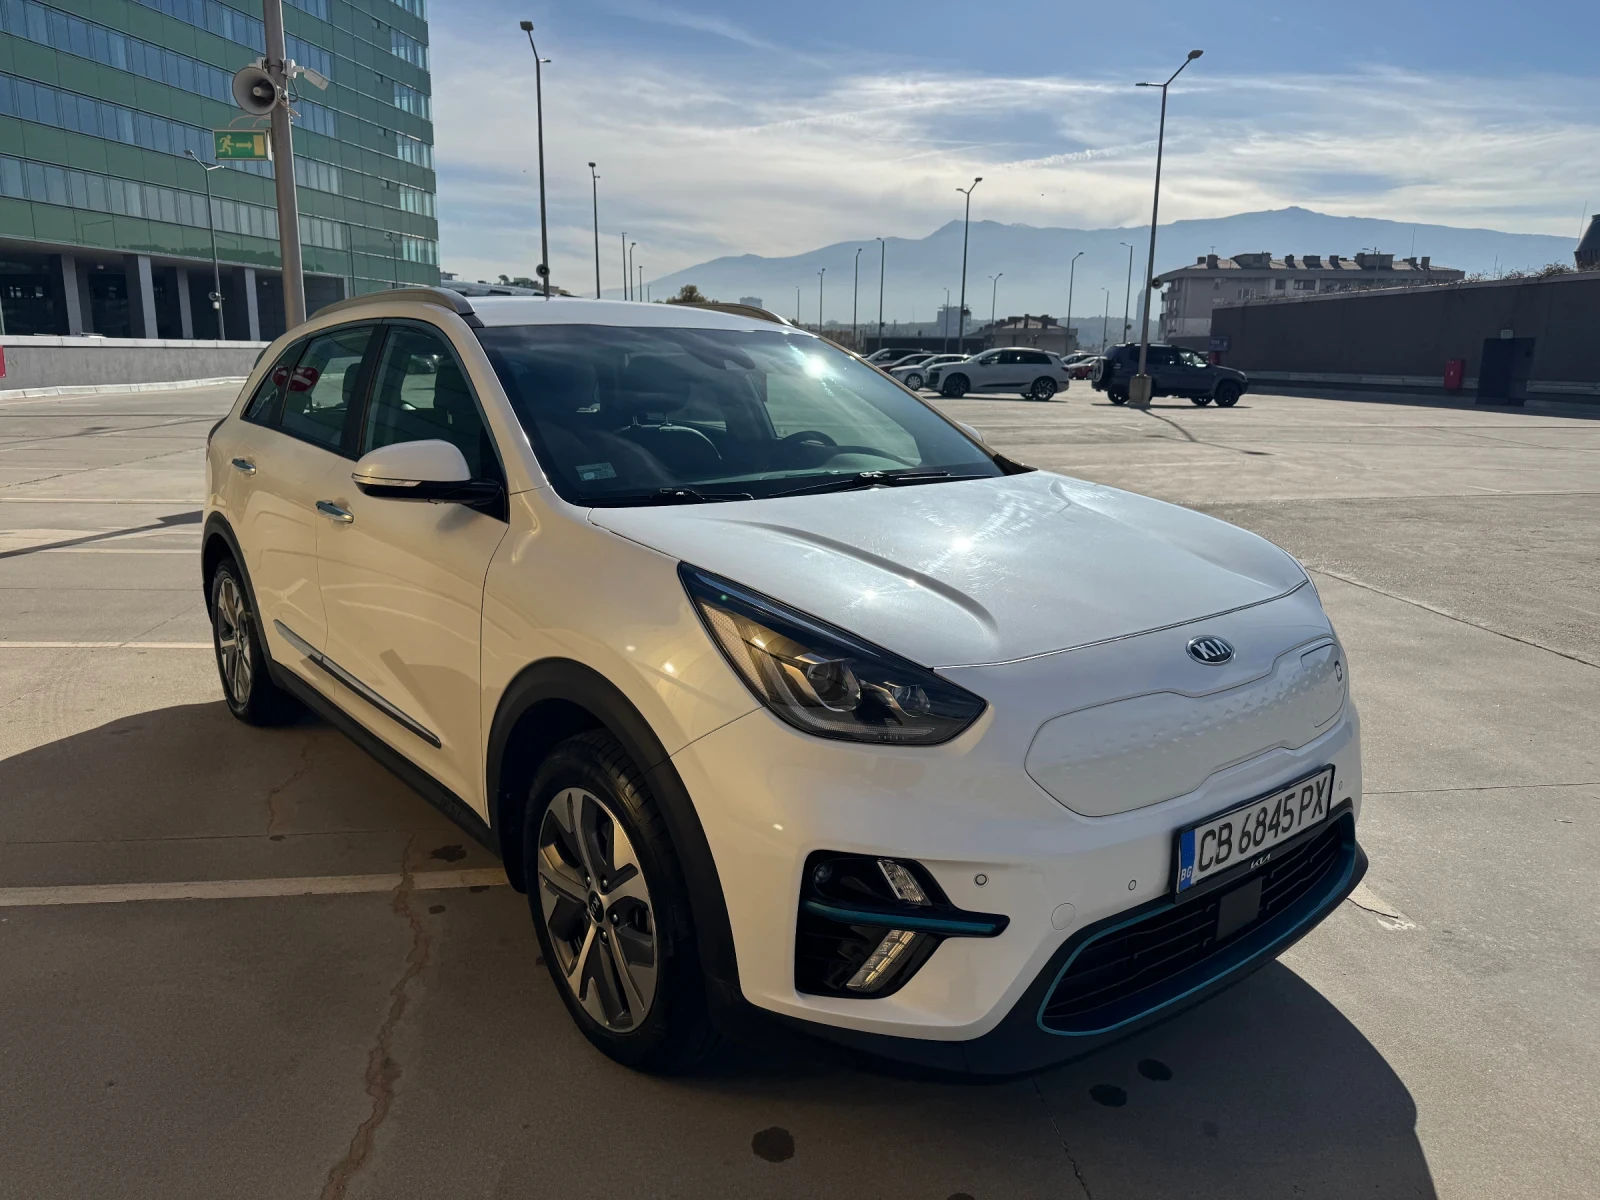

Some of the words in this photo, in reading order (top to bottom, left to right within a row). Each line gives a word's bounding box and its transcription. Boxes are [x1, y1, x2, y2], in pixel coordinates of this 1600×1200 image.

[1192, 639, 1231, 659] KIA
[1199, 822, 1232, 872] CB
[1238, 792, 1296, 855] 6845
[1297, 776, 1328, 826] PX
[1180, 865, 1193, 881] BG
